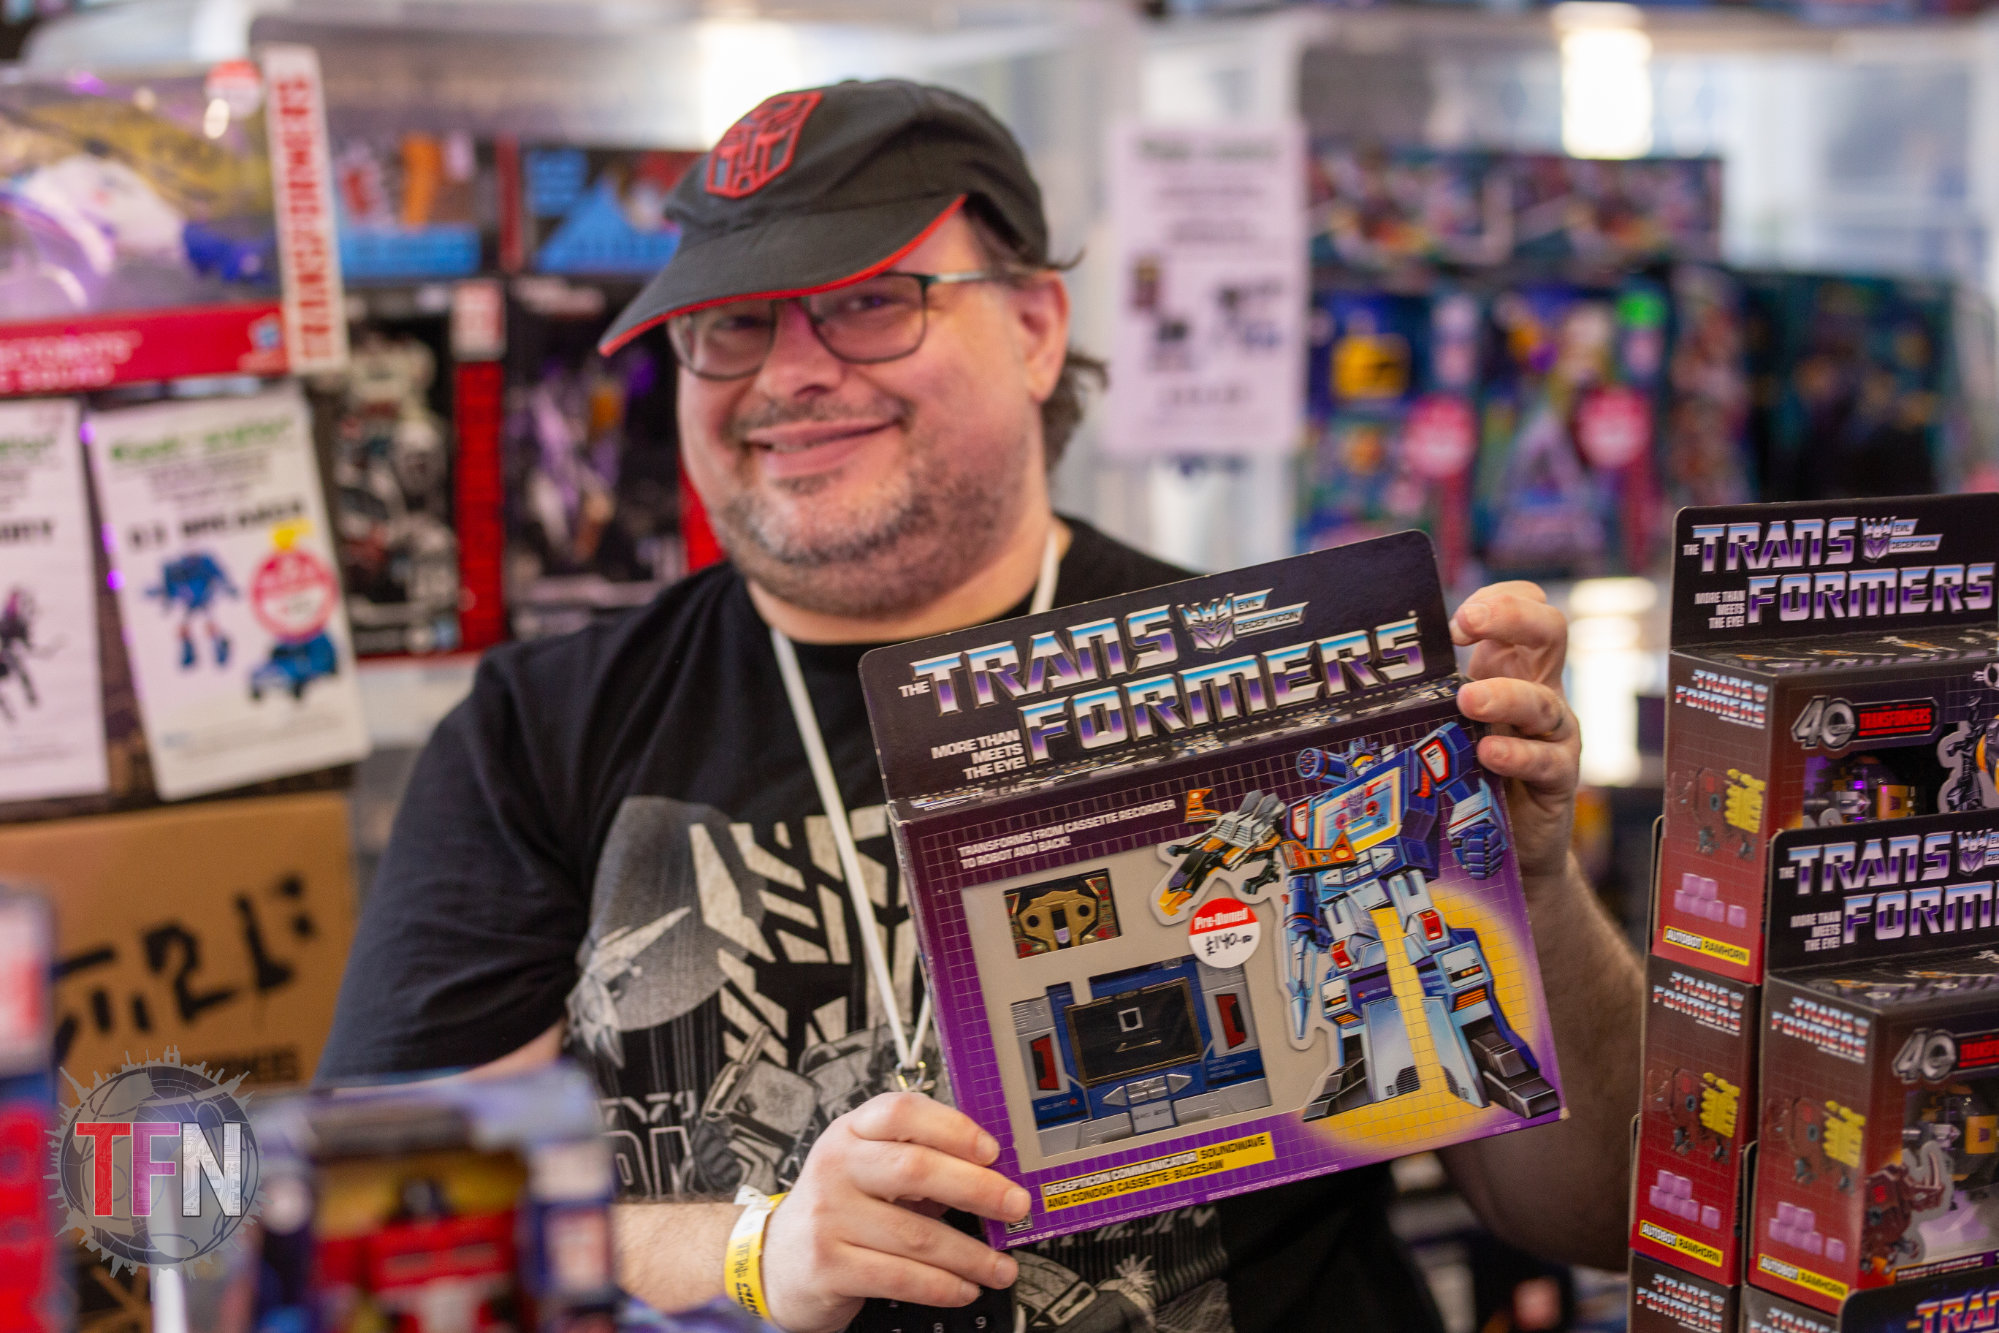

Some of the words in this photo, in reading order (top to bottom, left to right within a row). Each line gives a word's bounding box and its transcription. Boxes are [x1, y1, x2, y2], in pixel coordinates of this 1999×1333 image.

[1692, 517, 1857, 573] TRANS
[1237, 599, 1261, 612] EVIL
[1747, 562, 1996, 624] FORMERS
[1236, 611, 1301, 633] DECEPTICON
[909, 604, 1178, 717] TRANS
[898, 680, 931, 698] THE
[1018, 617, 1426, 765] FORMERS
[1675, 685, 1766, 724] FORMERS
[931, 738, 978, 760] MORE
[978, 728, 1021, 749] THAN
[1791, 695, 1855, 752] 40
[962, 762, 994, 780] THE
[993, 755, 1027, 774] EYE!
[971, 742, 1025, 765] MEETS
[957, 831, 1033, 858] TRANSFORMS
[1032, 823, 1065, 841] FROM
[1064, 810, 1119, 833] CASSETTE
[1118, 799, 1177, 820] RECORDER
[960, 857, 976, 870] TO
[976, 850, 1013, 868] ROBOT
[1013, 844, 1036, 859] AND
[1038, 836, 1071, 853] BACK!
[1787, 831, 1954, 895] TRANS
[1843, 880, 1999, 945] FORM
[1652, 985, 1742, 1031] FORMERS
[1771, 1011, 1867, 1059] FORMERS
[1044, 1170, 1112, 1197] DECEPTICON
[1111, 1151, 1198, 1180] COMMUNICATOR
[1200, 1136, 1267, 1160] SOUNDWAVE
[1047, 1194, 1069, 1209] AND
[1070, 1185, 1116, 1204] CONDOR
[1174, 1159, 1224, 1180] BUZZSAW
[1641, 1223, 1678, 1246] AUTOBOT
[1760, 1256, 1799, 1281] AUTOBOT
